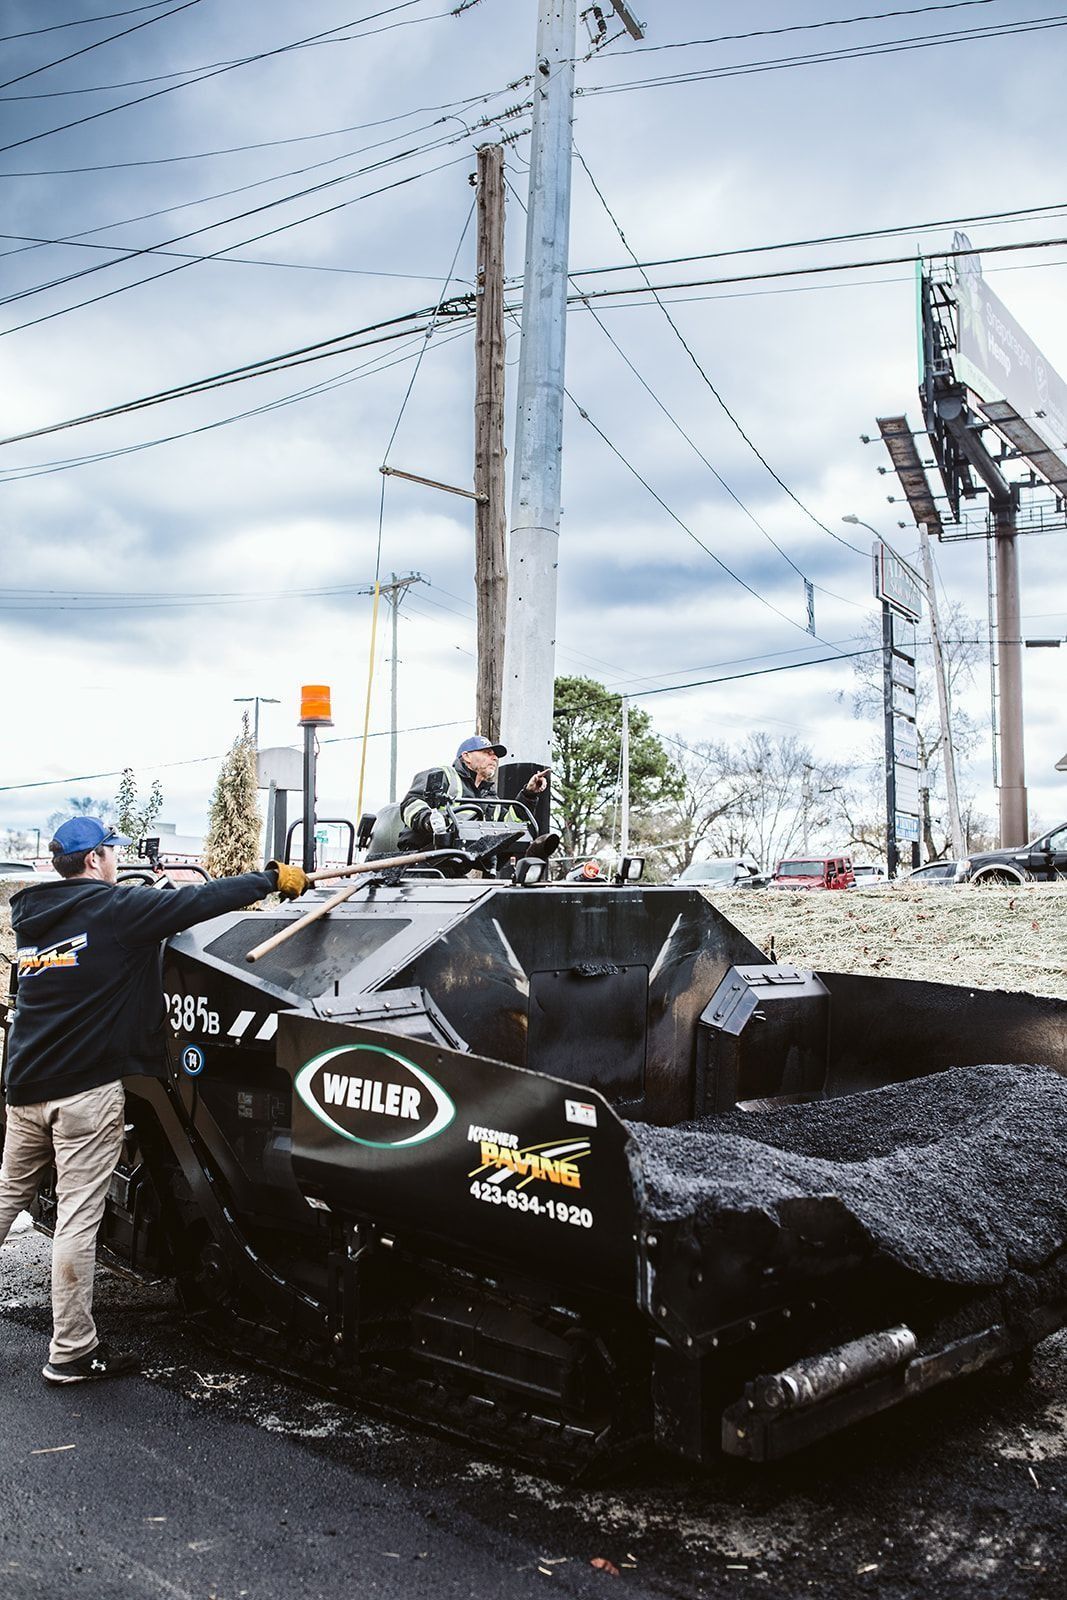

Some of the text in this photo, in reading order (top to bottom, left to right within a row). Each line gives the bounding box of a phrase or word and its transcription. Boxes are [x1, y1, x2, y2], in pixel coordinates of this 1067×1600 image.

[988, 330, 1011, 377] Hemp
[323, 1072, 422, 1120] WEILER
[480, 1140, 582, 1189] PAVING
[469, 1180, 594, 1229] 423-634-1920
